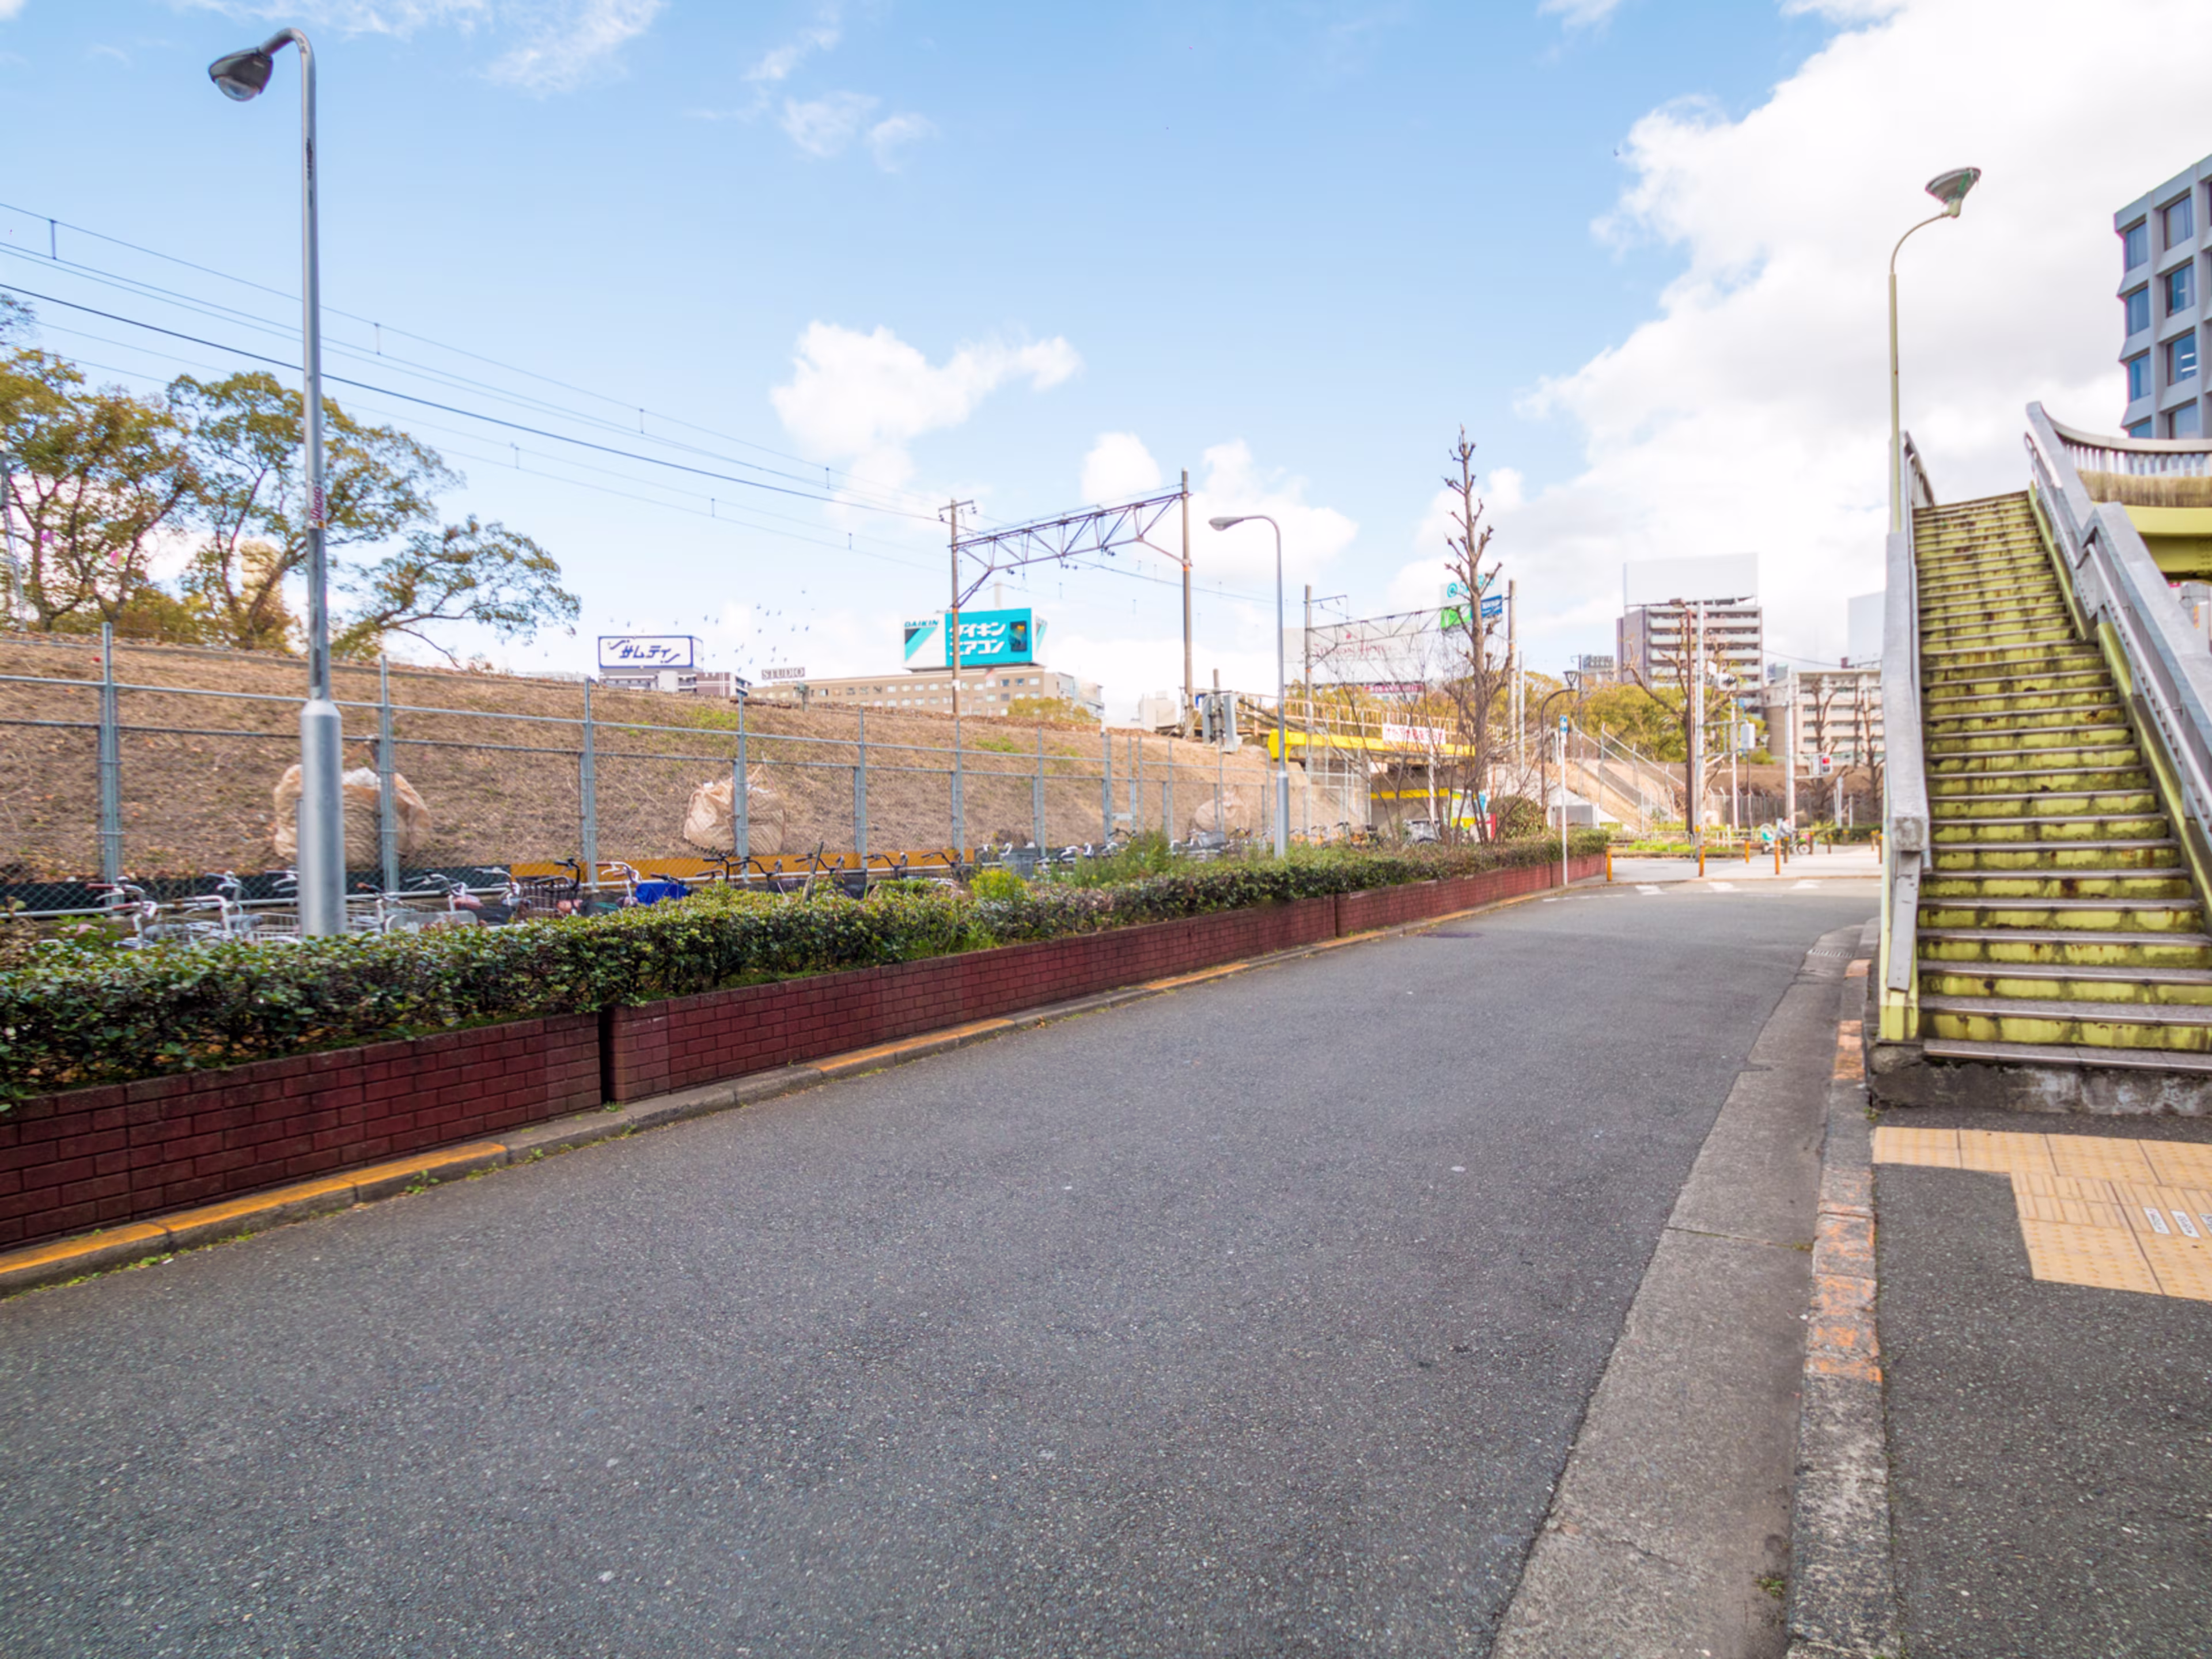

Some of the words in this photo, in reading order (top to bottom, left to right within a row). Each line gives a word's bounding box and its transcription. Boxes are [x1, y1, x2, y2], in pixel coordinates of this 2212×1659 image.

[904, 619, 938, 627] DAIKIN
[619, 645, 672, 658] サムティ
[762, 668, 805, 680] STUDIO
